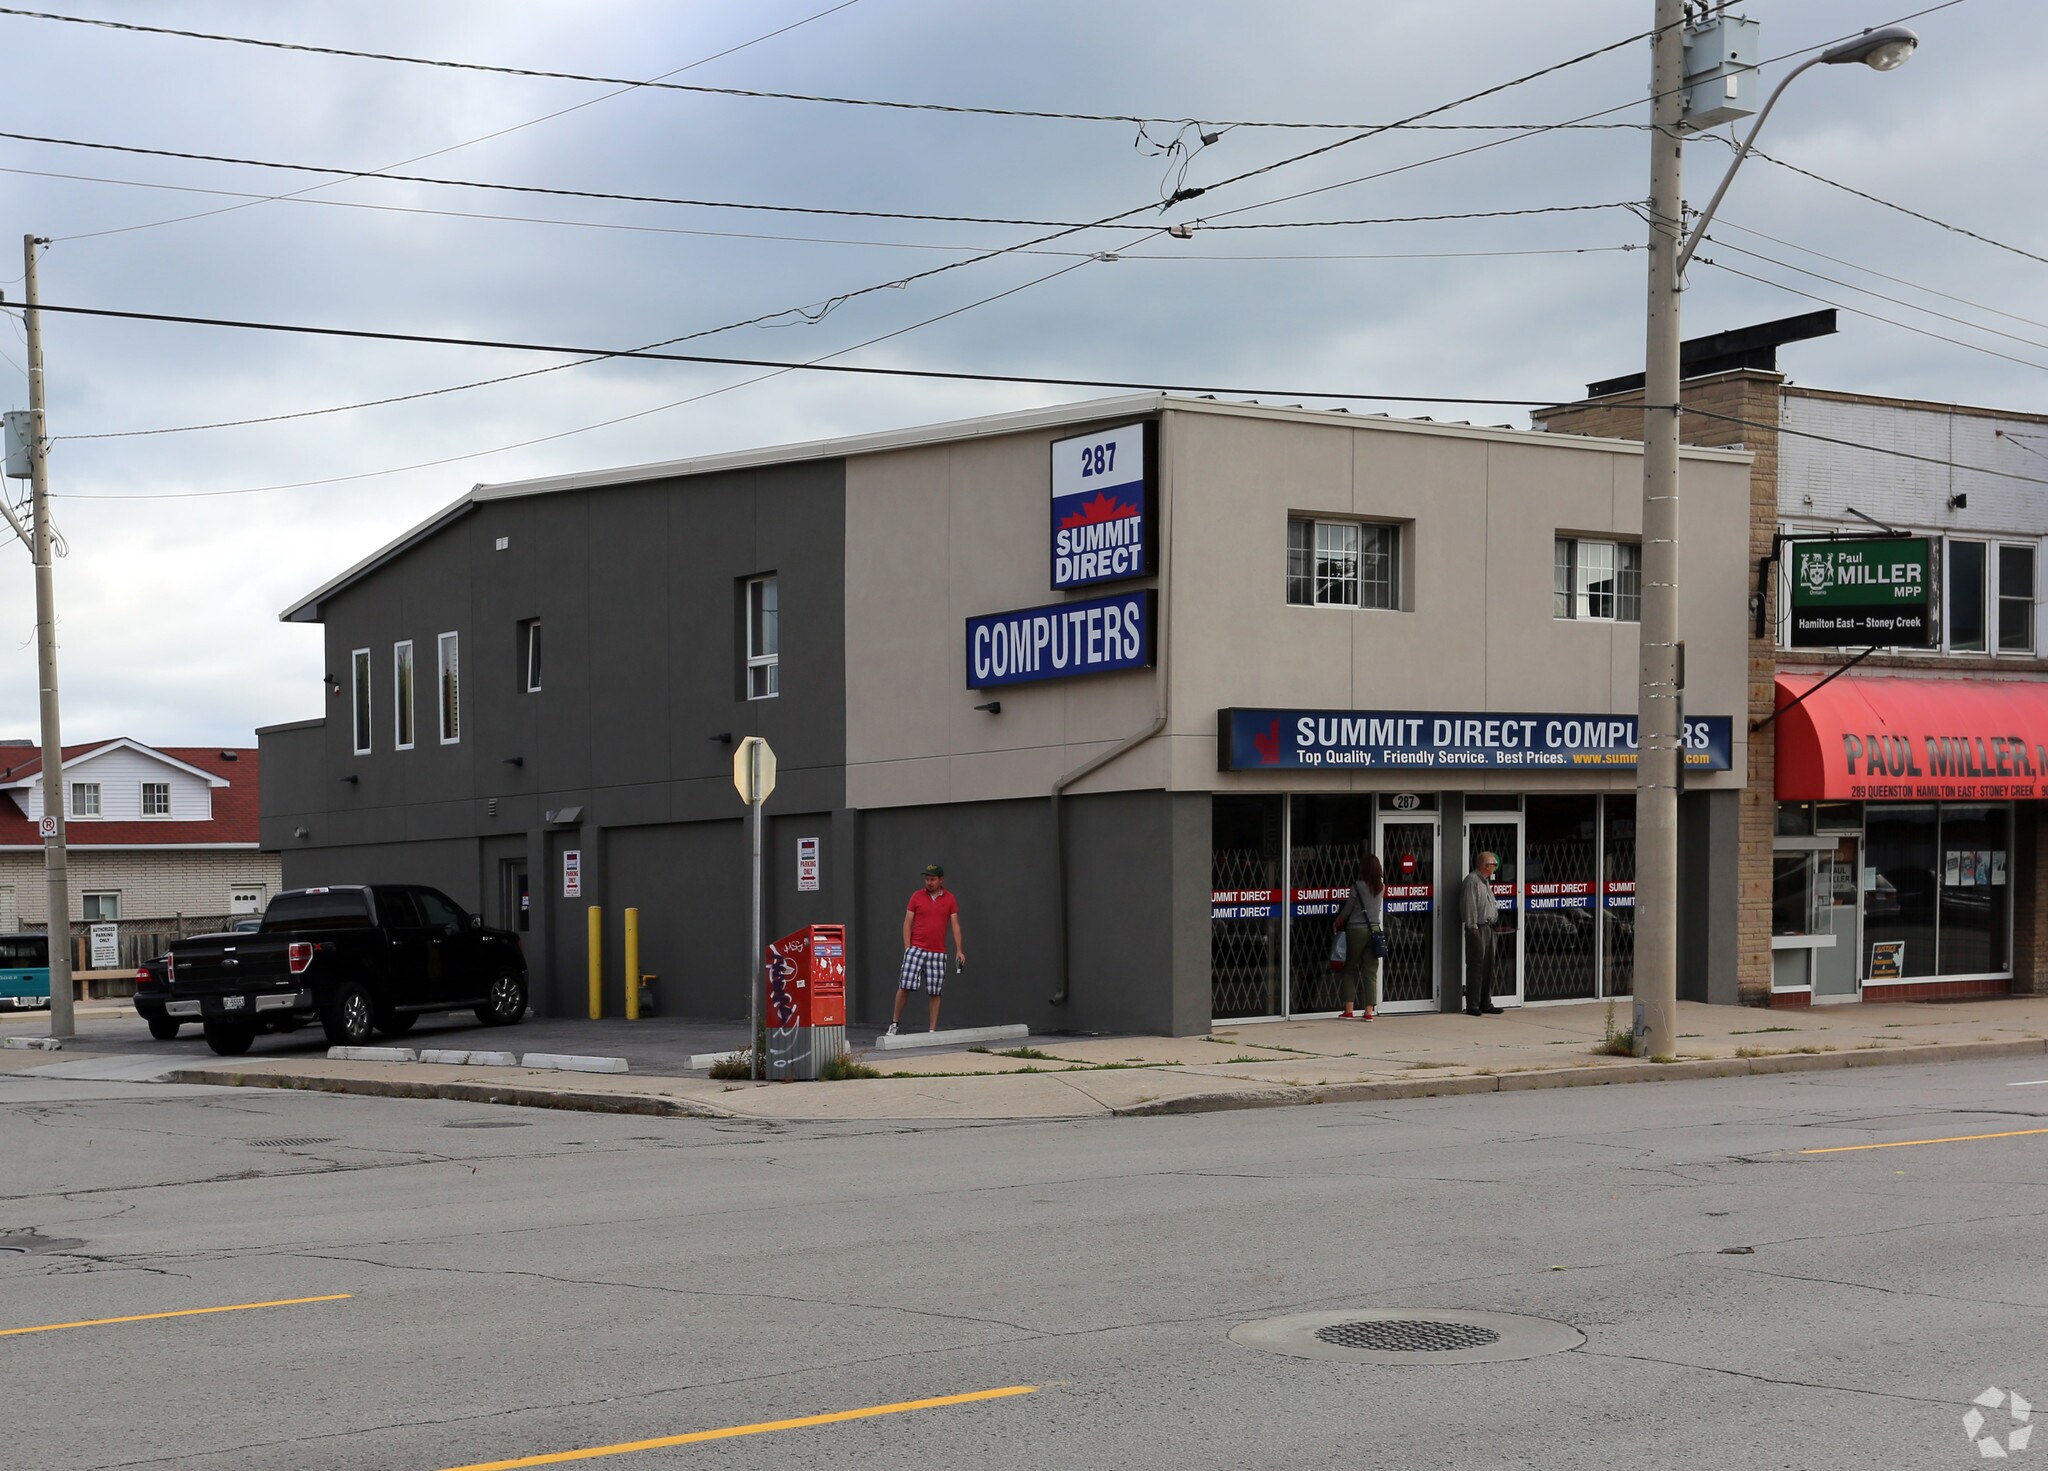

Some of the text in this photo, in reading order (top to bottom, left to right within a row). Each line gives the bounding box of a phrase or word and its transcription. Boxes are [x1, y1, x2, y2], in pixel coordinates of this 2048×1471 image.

[1081, 442, 1117, 477] 287
[1056, 515, 1141, 556] SUMMIT
[1838, 552, 1862, 563] Paul
[1055, 544, 1141, 584] DIRECT
[1837, 563, 1921, 585] MILLER
[1894, 586, 1921, 598] MPP
[1799, 618, 1834, 629] Hamilton
[1836, 618, 1854, 629] East
[1866, 617, 1894, 630] Stoney
[1896, 616, 1921, 628] Creek
[974, 601, 1140, 679] COMPUTERS
[1297, 717, 1710, 749] SUMMIT DIRECT COMPURS
[1297, 750, 1321, 765] Top
[1326, 750, 1375, 765] Quality.
[1384, 750, 1434, 766] Friendly
[1438, 751, 1488, 764] Service.
[1496, 752, 1523, 764] Best
[1527, 752, 1567, 764] Prices.
[1842, 733, 1922, 777] PAUL
[1924, 736, 2036, 783] MILLER,
[1851, 785, 1866, 797] 289
[1868, 785, 1913, 797] QUEENSTON
[1916, 785, 1955, 797] HAMILTON
[2011, 785, 2034, 797] CREEK
[1398, 795, 1414, 808] 287
[1830, 867, 1847, 875] AUL
[1387, 886, 1428, 897] SUMMIT DIRECT
[1494, 884, 1513, 895] DIRECT
[1531, 883, 1588, 894] SUMMIT DIRECT
[1609, 882, 1635, 892] SUMMIT
[1211, 891, 1271, 902] UMMIT DIRECT
[1297, 888, 1350, 900] SUMMIT DIRE
[1387, 901, 1428, 912] SUMMIT DIRECT
[1531, 897, 1588, 909] SUMMIT DIRECT
[1609, 897, 1635, 907] SUMMIT
[1211, 907, 1271, 918] UMMIT DIRECT
[1297, 904, 1329, 915] SUMMIT
